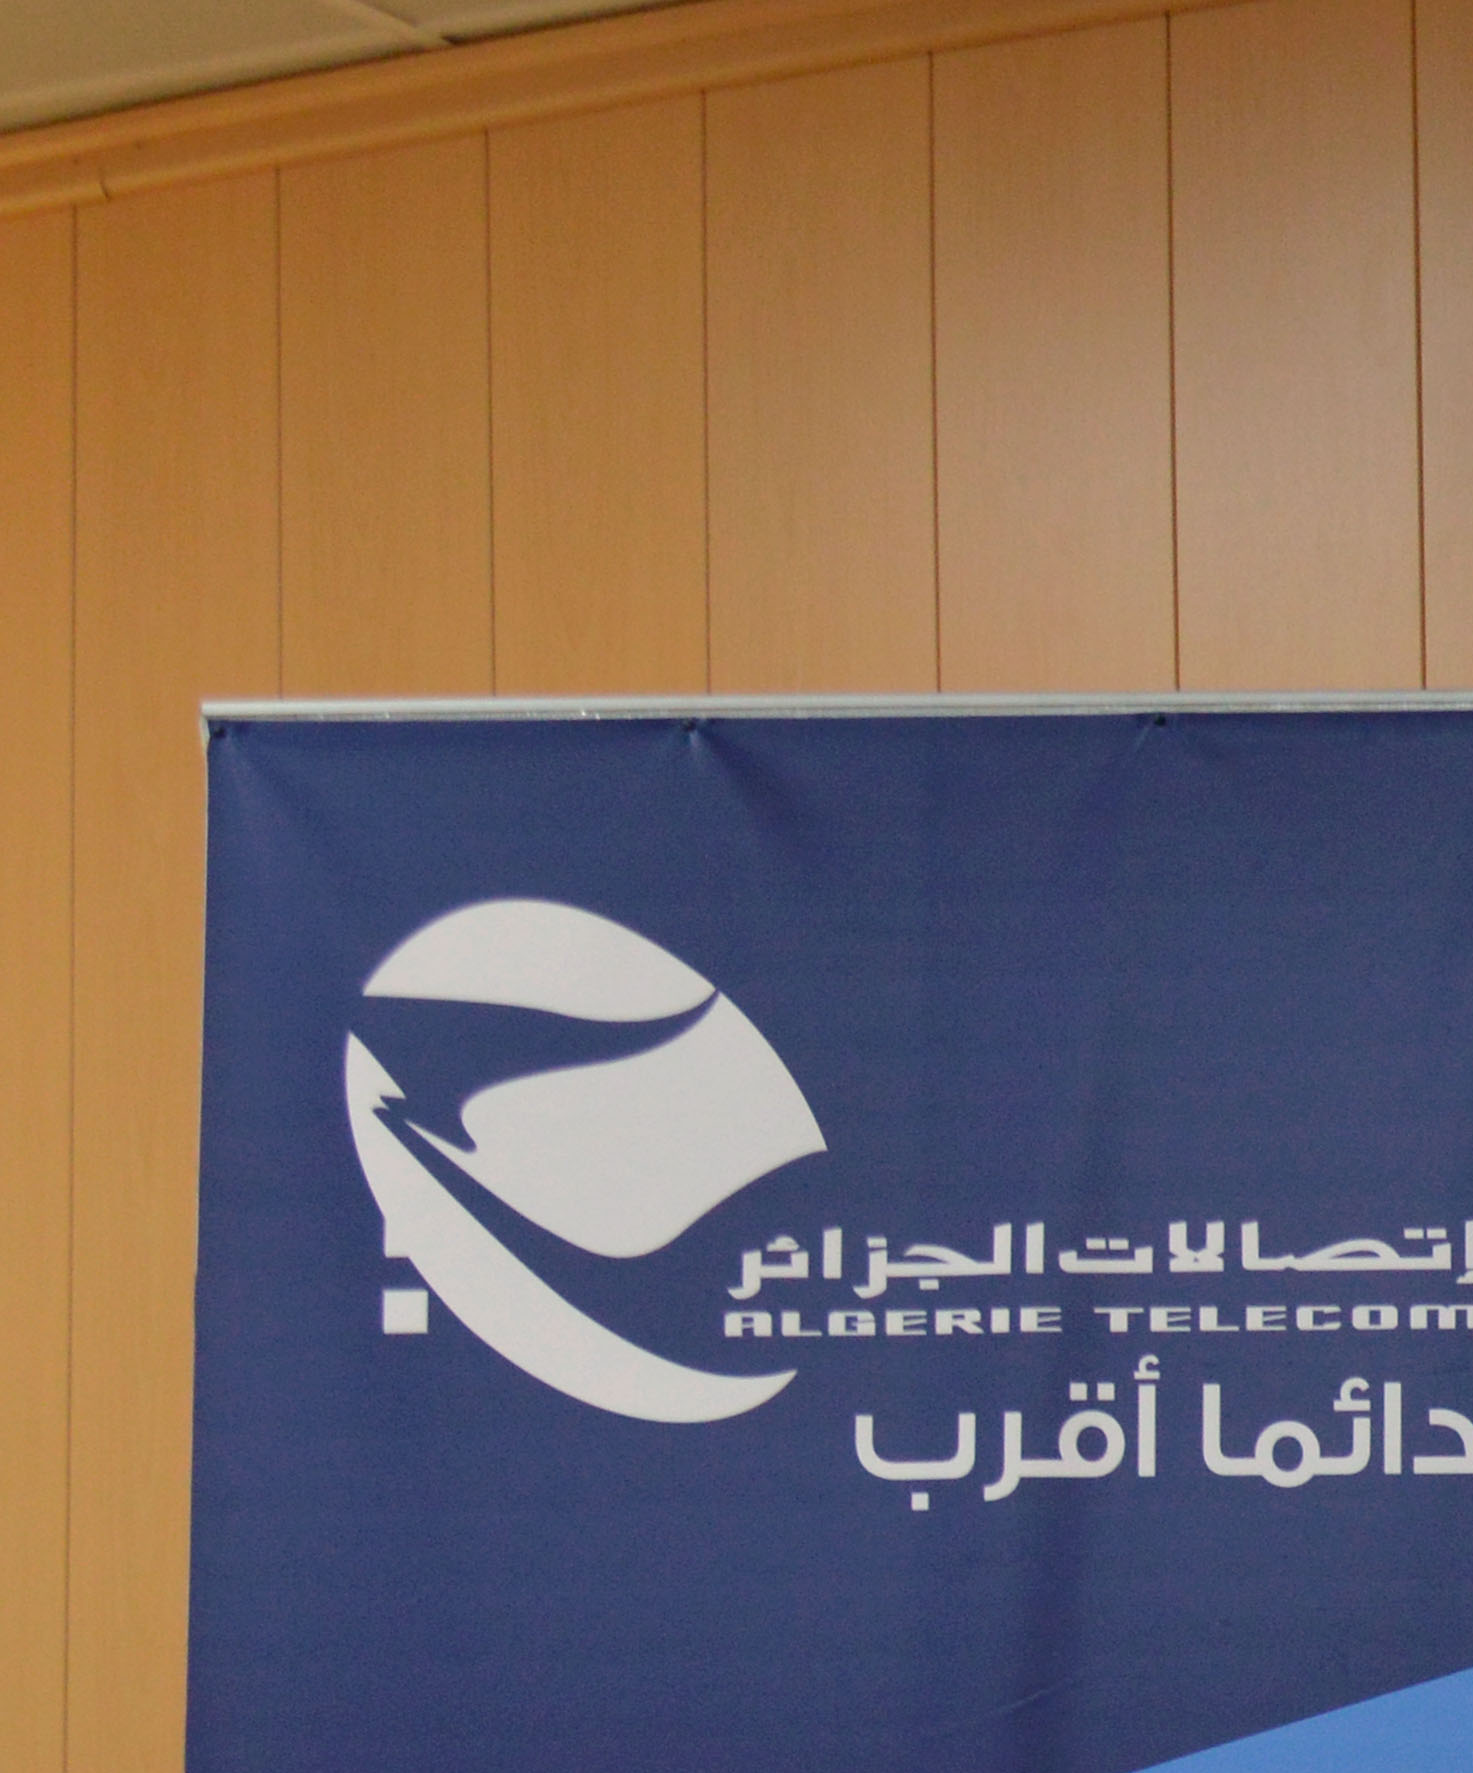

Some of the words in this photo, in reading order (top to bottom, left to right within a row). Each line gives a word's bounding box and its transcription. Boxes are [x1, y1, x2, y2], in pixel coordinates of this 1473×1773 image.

[727, 1222, 1044, 1300] الجزائر
[723, 1306, 1062, 1338] ALGERIE
[854, 1354, 1163, 1512] أقرب
